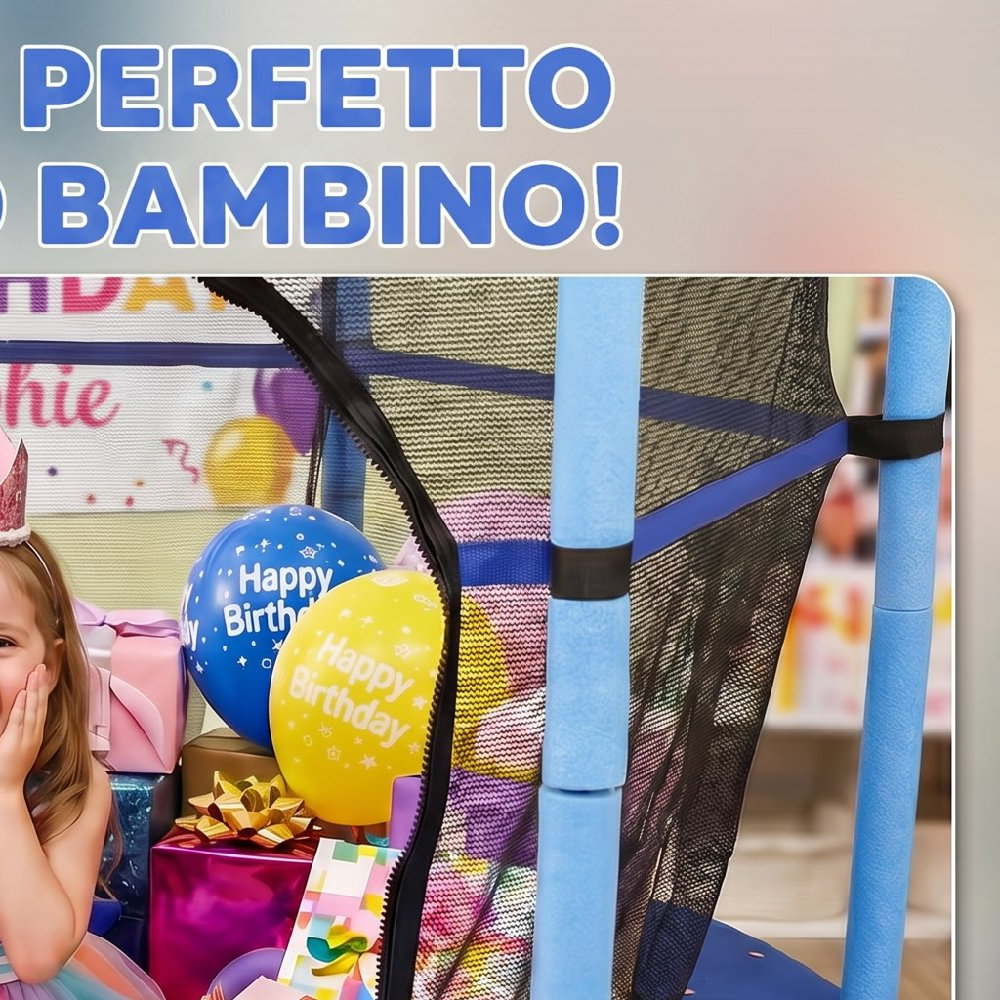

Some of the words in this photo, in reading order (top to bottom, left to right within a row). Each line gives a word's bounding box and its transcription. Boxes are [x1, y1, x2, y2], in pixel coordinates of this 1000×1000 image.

[239, 562, 334, 598] Happy
[315, 632, 415, 702] Happy
[288, 666, 409, 748] Birthday
